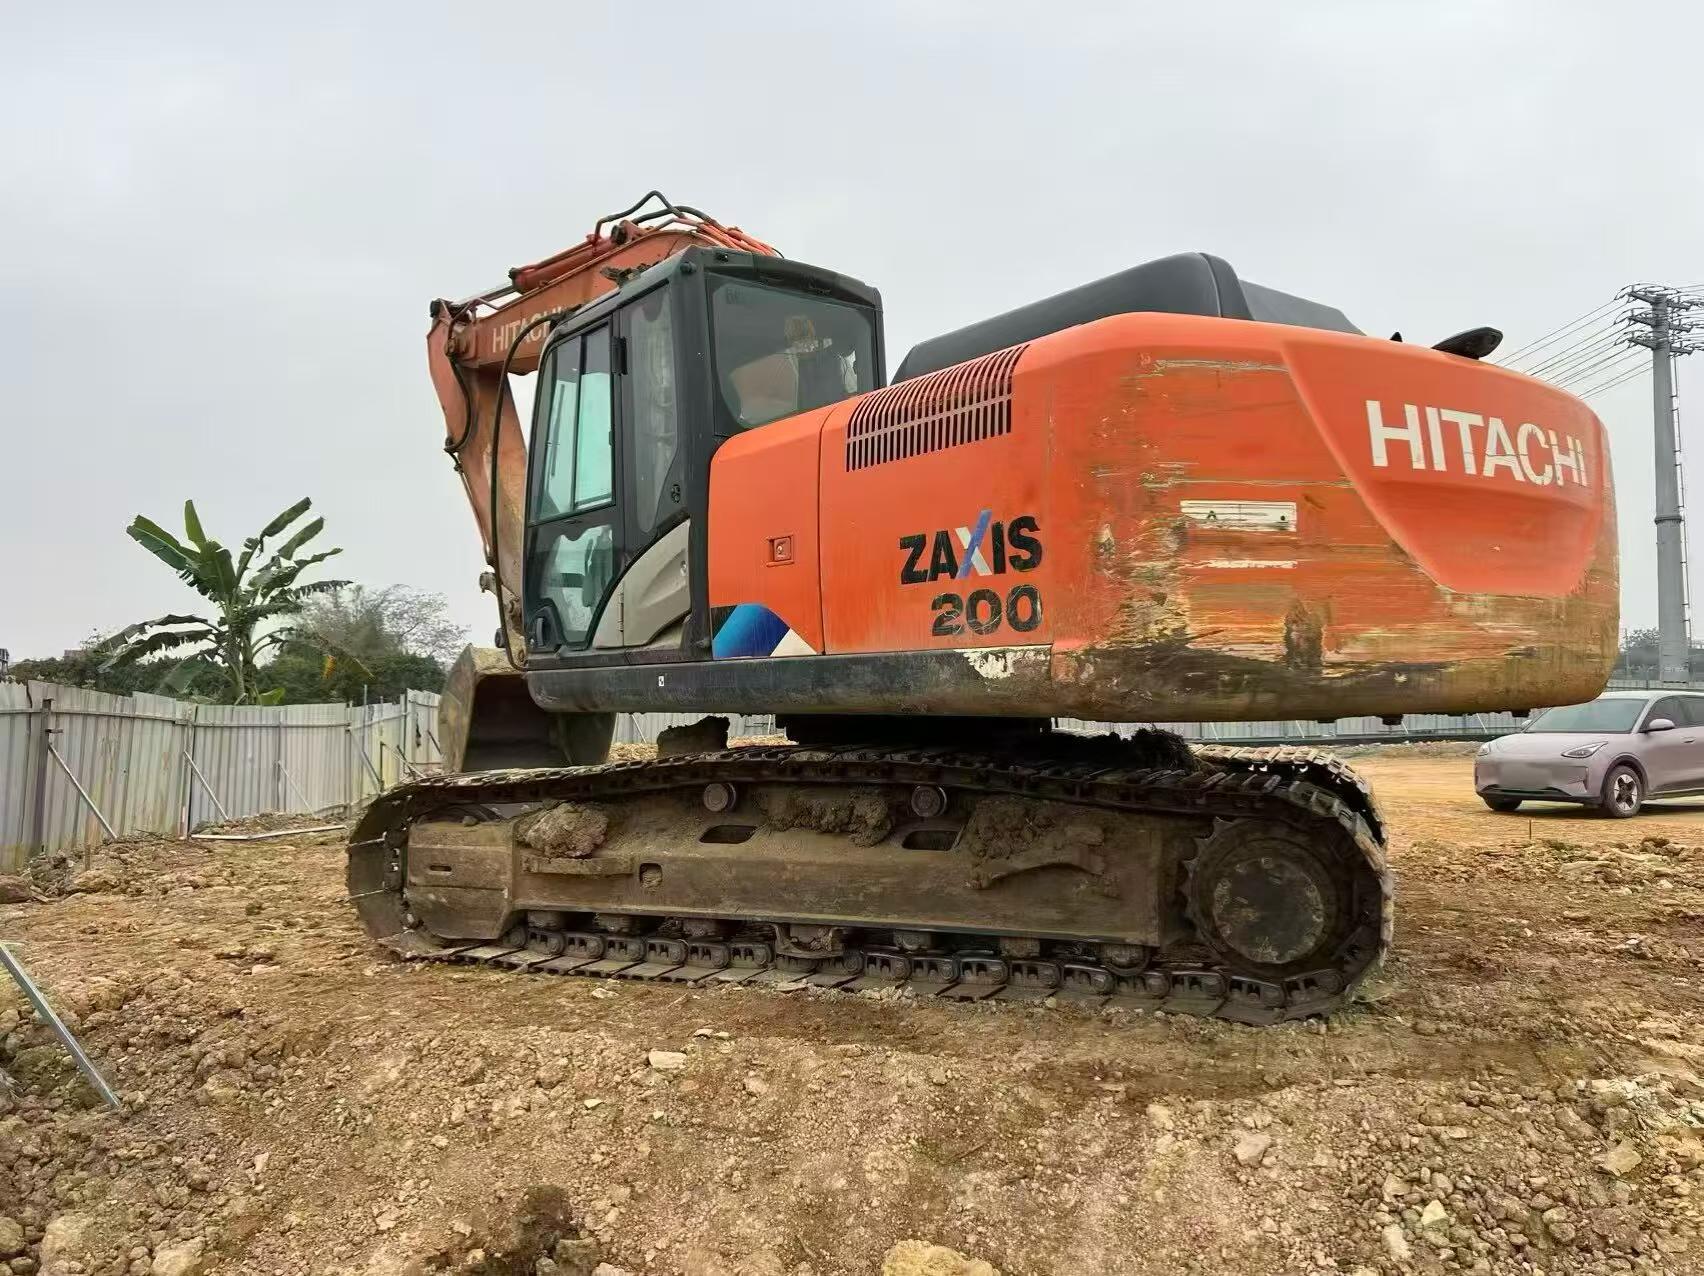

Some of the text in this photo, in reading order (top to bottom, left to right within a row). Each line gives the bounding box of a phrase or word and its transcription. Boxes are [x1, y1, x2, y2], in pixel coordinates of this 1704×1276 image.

[493, 307, 561, 352] HITACH
[1366, 400, 1588, 487] HITACHI
[899, 509, 1042, 585] ZAXIS
[931, 584, 1043, 636] 200
